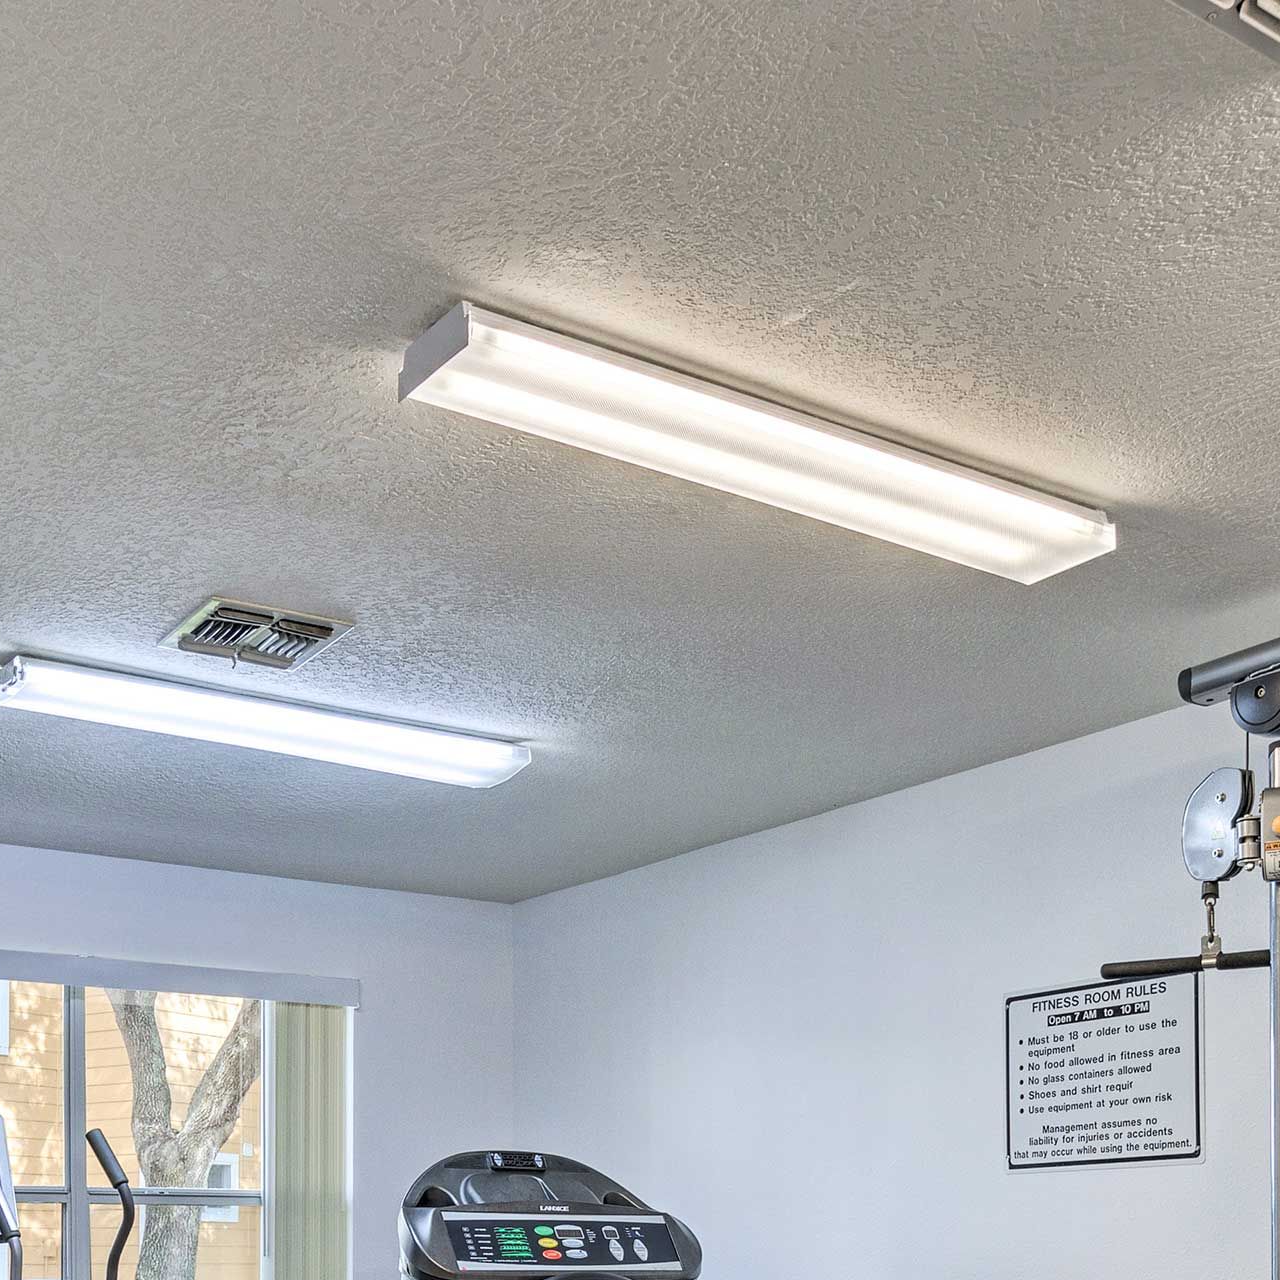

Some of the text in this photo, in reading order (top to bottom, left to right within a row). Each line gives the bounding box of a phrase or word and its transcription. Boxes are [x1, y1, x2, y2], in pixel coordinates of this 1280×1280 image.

[1032, 982, 1167, 1013] FITNESS ROOM RULES
[1048, 1002, 1149, 1026] Open 7 AM to 10 PM
[1028, 1018, 1177, 1046] Must be 18 or older to use the
[1028, 1044, 1075, 1058] equipment
[1028, 1046, 1180, 1071] No food allowed in fitness area
[1028, 1064, 1152, 1085] No glass containers allowed
[1029, 1091, 1057, 1100] Shoes
[1061, 1087, 1077, 1096] and
[1081, 1084, 1102, 1095] shirt
[1029, 1093, 1173, 1114] Use equipment at your own risk
[1042, 1117, 1158, 1134] Management assumes no
[1029, 1136, 1059, 1147] liability
[1062, 1135, 1074, 1144] for
[1078, 1132, 1110, 1143] injuries
[1127, 1128, 1173, 1138] accidents
[1014, 1139, 1192, 1160] that may occur while using the equipment.
